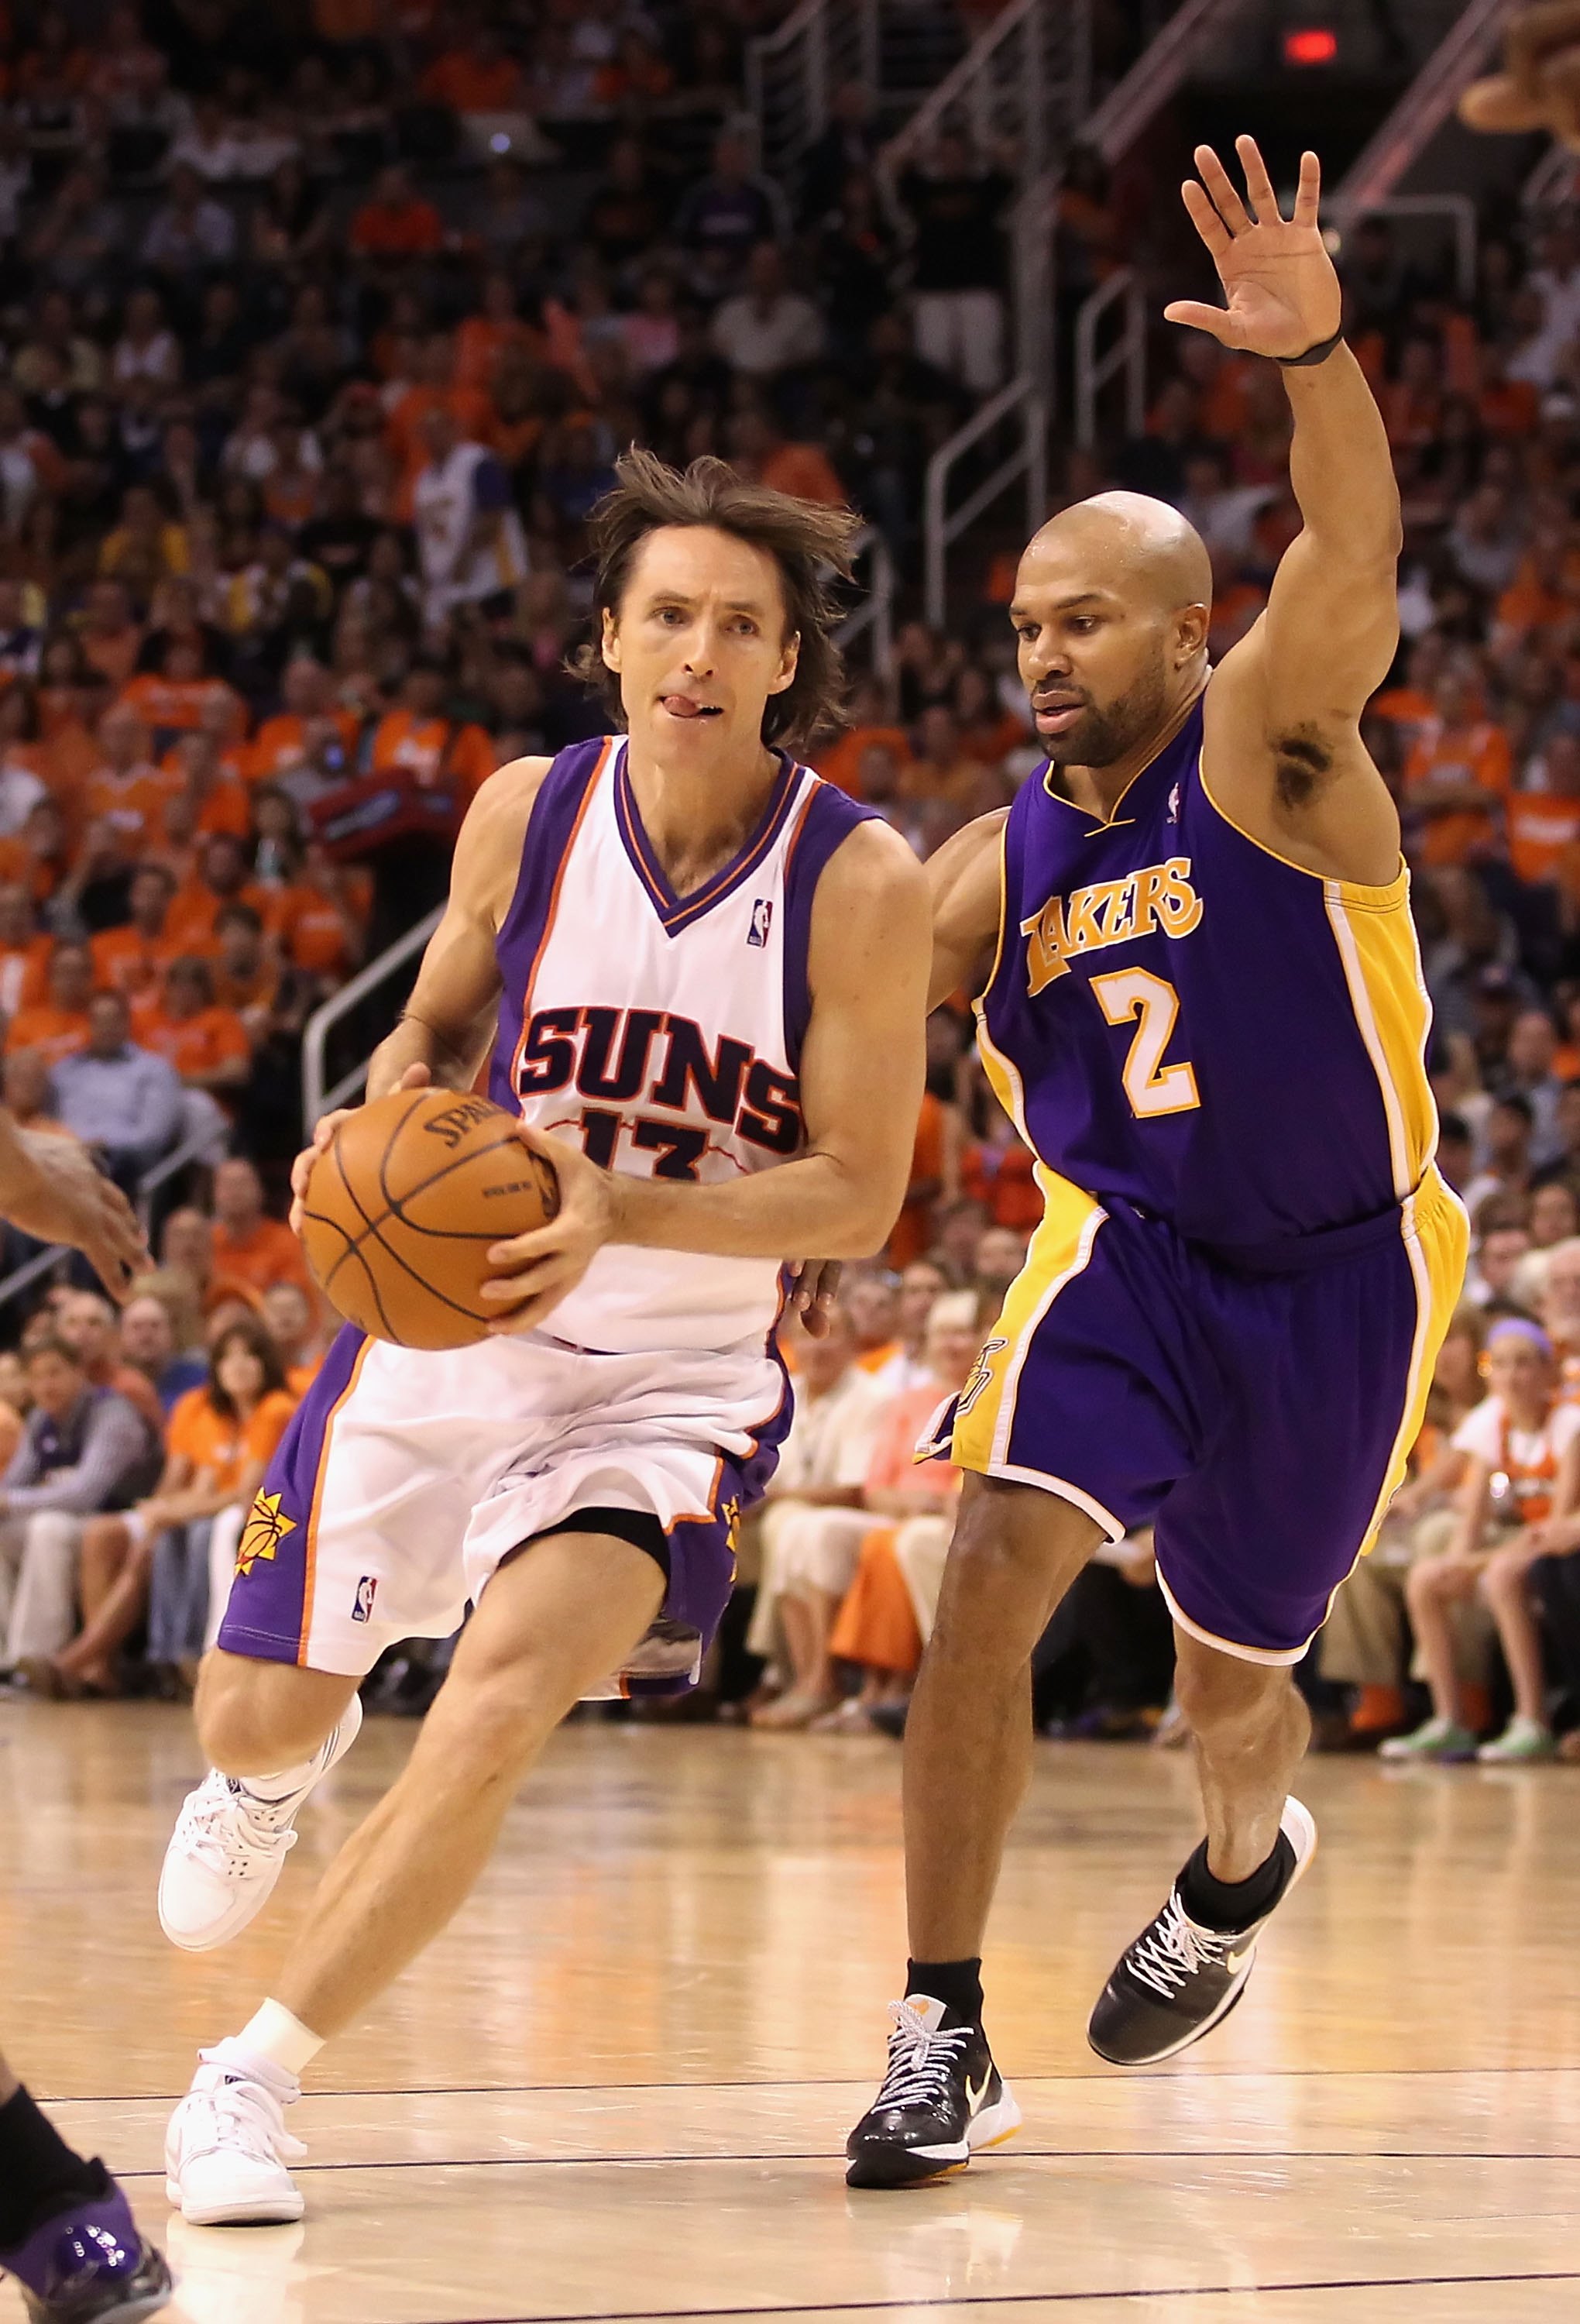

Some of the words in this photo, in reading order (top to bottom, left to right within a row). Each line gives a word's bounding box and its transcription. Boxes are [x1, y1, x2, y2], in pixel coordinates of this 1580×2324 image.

[1019, 857, 1204, 998] LAKERS
[518, 1006, 802, 1155] SUNS
[1088, 966, 1201, 1119] 2
